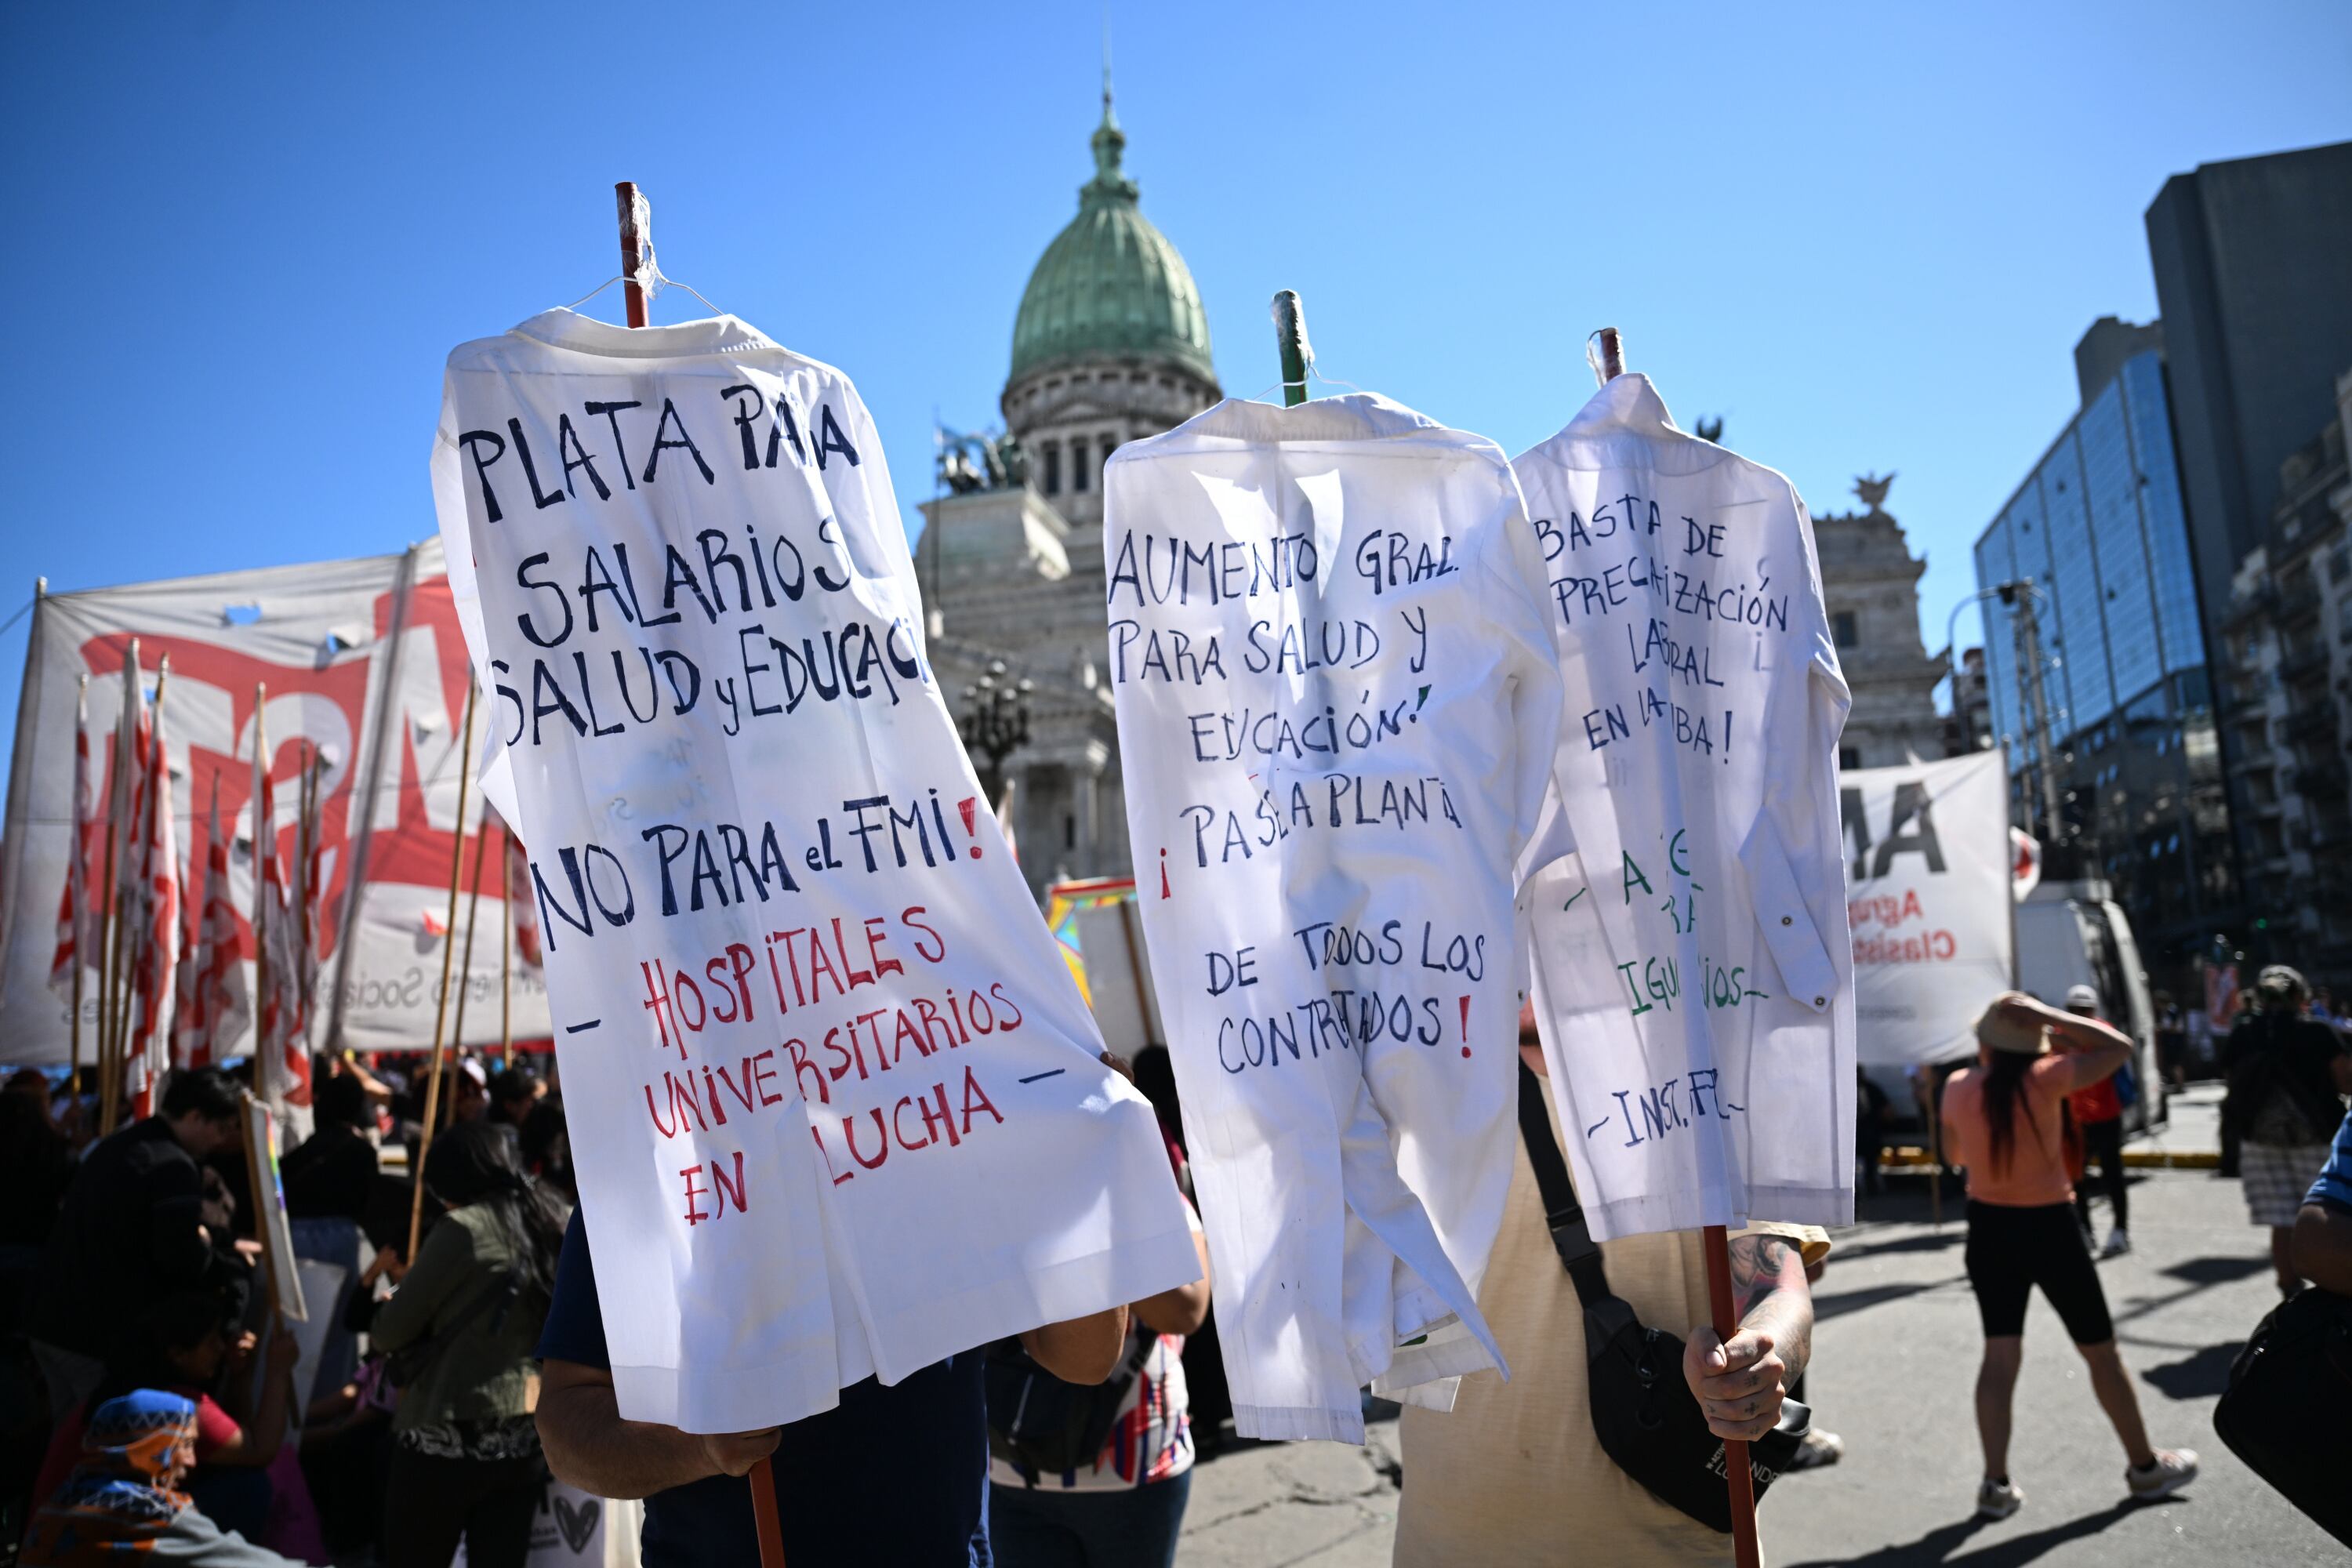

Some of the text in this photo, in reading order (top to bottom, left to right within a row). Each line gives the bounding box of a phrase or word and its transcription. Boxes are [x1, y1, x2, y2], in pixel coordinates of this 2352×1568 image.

[459, 383, 862, 522] PLATA PAA
[1108, 529, 1318, 607] AUMENTO
[1534, 493, 1726, 561] BASTA DE
[491, 647, 701, 746] SALUD
[1108, 619, 1227, 684] PARA
[1243, 617, 1380, 675] SALUD
[1583, 704, 1630, 750] EN
[1638, 687, 1668, 728] LA
[531, 844, 634, 951] NO
[642, 822, 800, 916] PARA
[641, 906, 945, 1060] HOSPITALES
[1205, 946, 1258, 996] DE
[1421, 920, 1485, 982] LOS
[644, 983, 1022, 1138] UNIVERSITARIOS
[681, 1065, 1004, 1225] EN LUCHA
